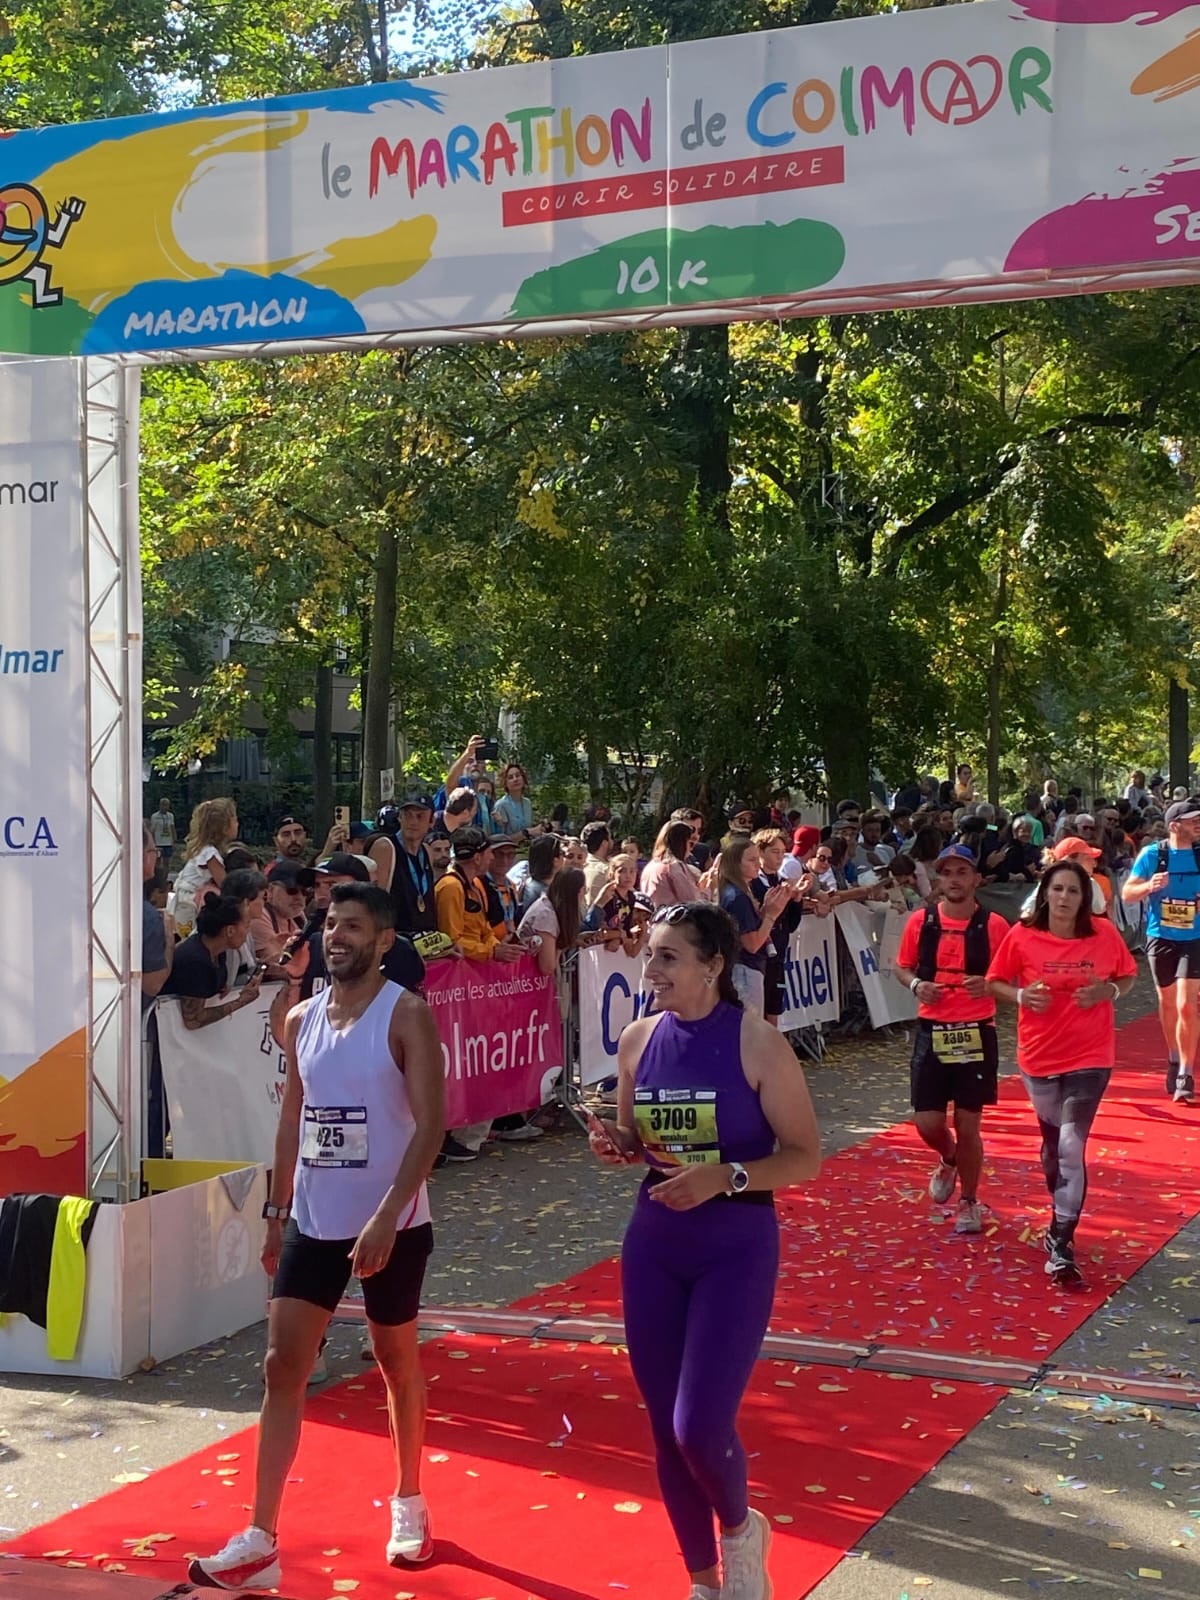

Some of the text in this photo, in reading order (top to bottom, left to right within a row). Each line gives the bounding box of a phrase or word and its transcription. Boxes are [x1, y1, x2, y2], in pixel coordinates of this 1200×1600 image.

[321, 141, 352, 200] le
[369, 96, 652, 200] MARATHON
[680, 98, 727, 151] de
[521, 157, 823, 214] COURIR SOLIDAIRE
[616, 256, 708, 294] 10 K
[123, 297, 308, 339] MARATHON
[4, 816, 59, 849] CA
[467, 980, 485, 999] les
[487, 974, 533, 998] actualités
[534, 975, 549, 991] sur
[650, 1107, 697, 1131] 3709
